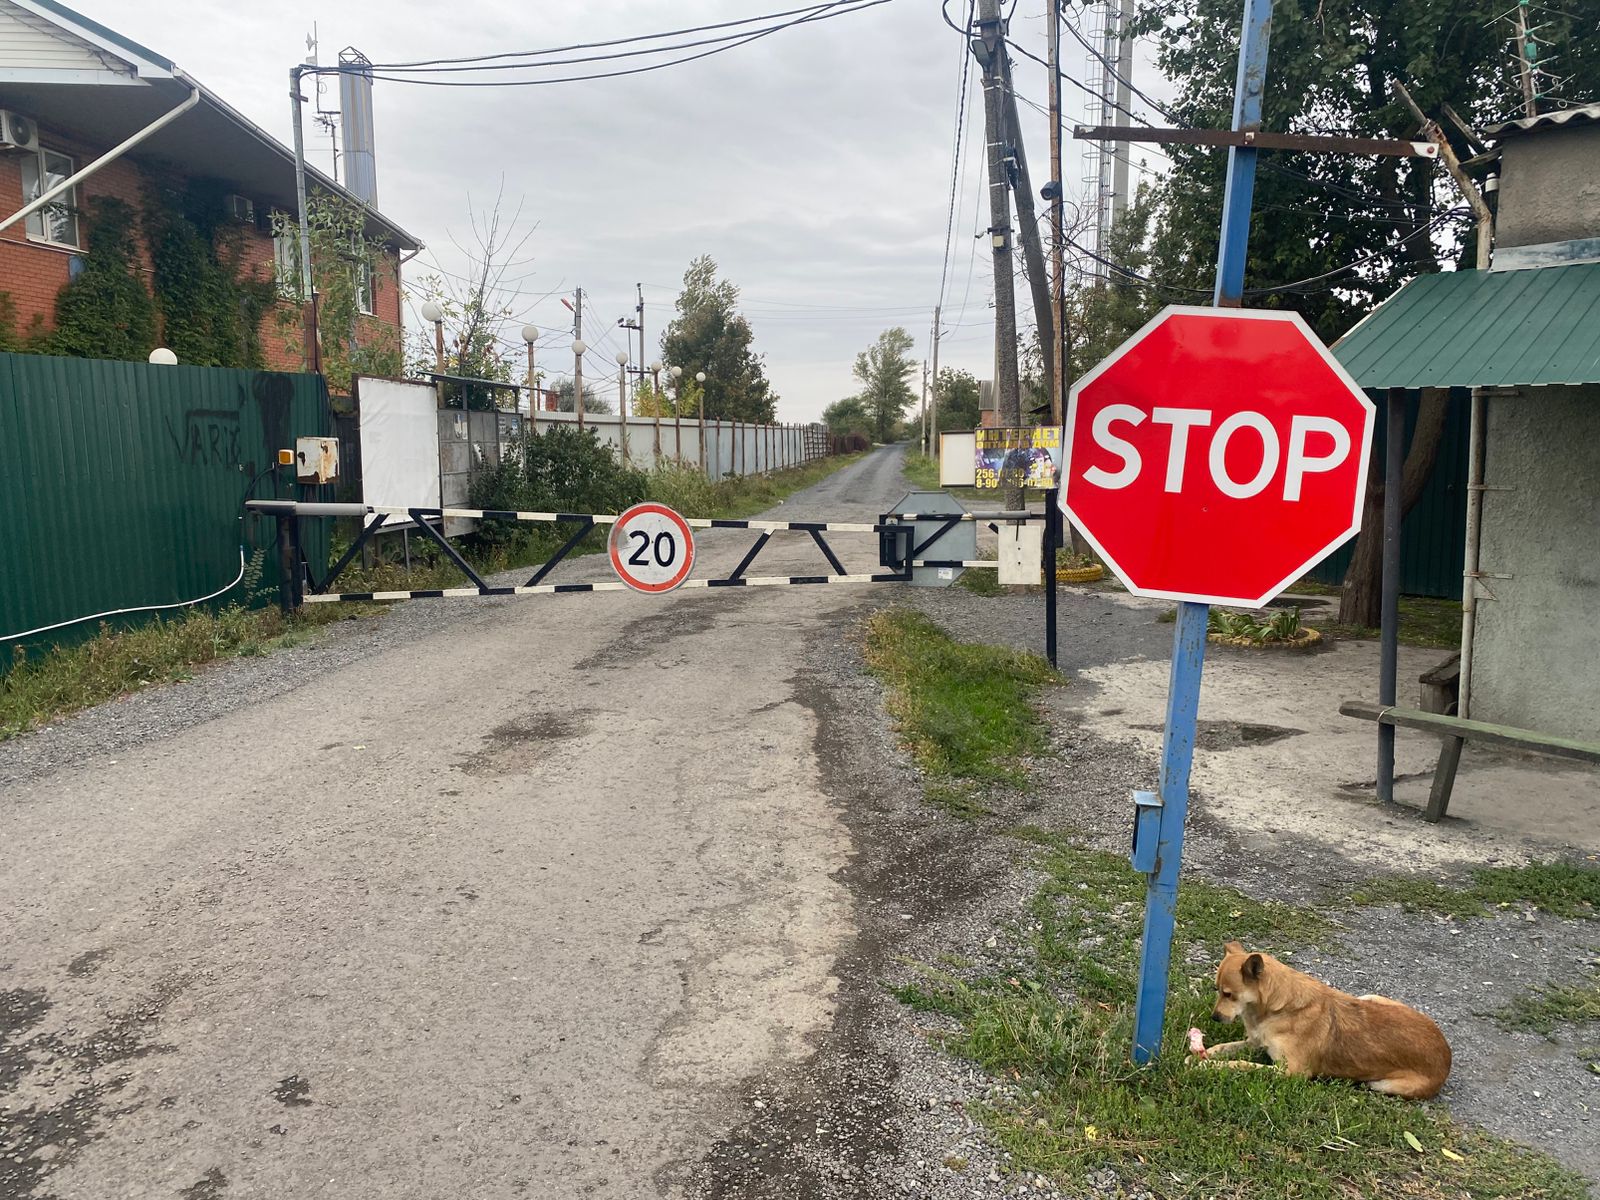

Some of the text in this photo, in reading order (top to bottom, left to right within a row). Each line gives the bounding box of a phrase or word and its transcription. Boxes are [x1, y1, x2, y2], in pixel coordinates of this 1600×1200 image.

[976, 428, 1060, 441] ИНТЕРНЕТ
[1032, 440, 1060, 448] ДОМ
[1082, 403, 1351, 502] STOP
[628, 530, 675, 567] 20
